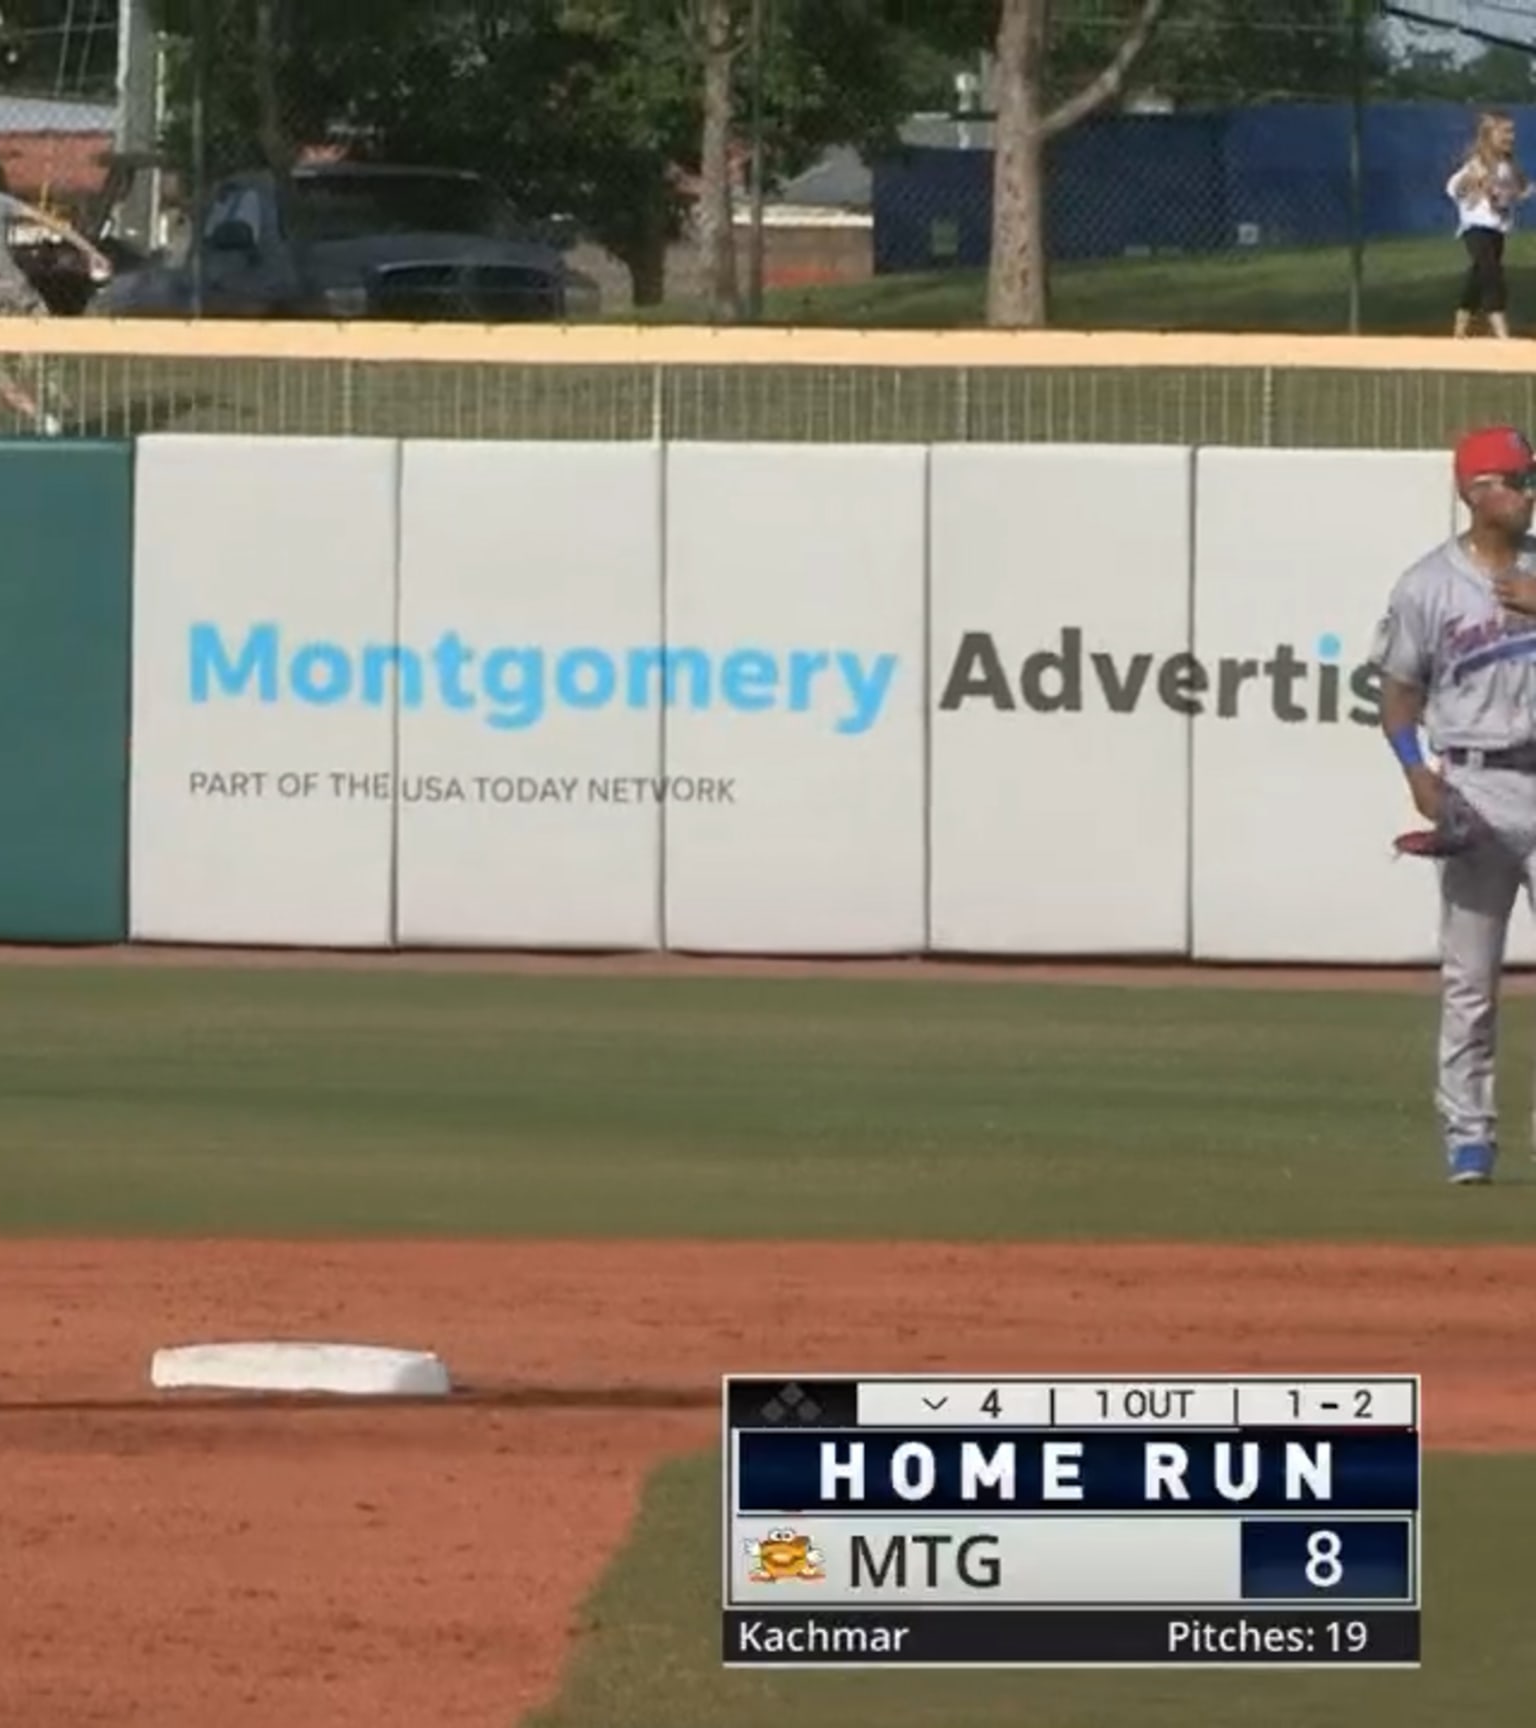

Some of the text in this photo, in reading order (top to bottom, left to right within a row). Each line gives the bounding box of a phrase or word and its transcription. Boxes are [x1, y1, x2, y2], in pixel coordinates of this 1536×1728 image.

[188, 622, 898, 736] Montgomery
[939, 626, 1382, 726] Advertis
[189, 771, 266, 796] PART
[277, 772, 319, 798] OF
[330, 773, 389, 799] THE
[401, 777, 465, 802] USA
[476, 776, 578, 803] TODAY
